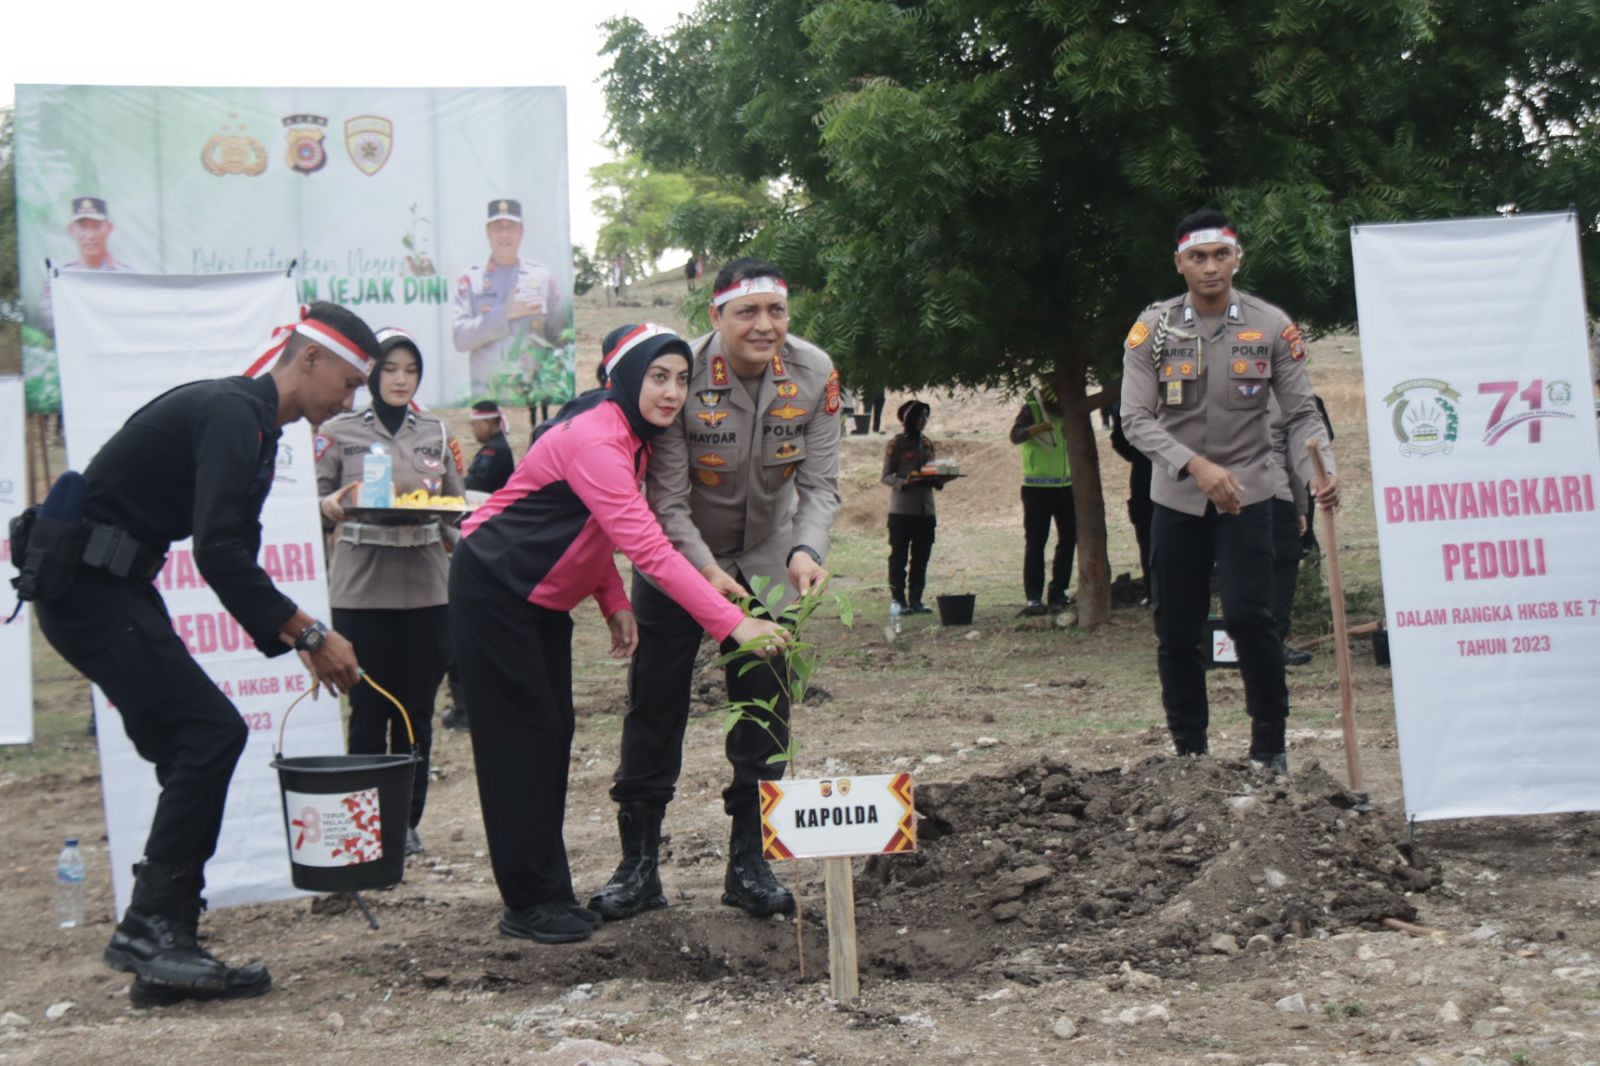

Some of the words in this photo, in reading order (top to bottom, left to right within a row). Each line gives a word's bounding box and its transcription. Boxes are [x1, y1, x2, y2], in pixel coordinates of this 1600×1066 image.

[328, 276, 394, 304] SEJAK
[404, 277, 448, 304] DINI
[1231, 346, 1268, 356] POLRI
[1478, 379, 1543, 444] 71
[1384, 474, 1595, 524] BHAYANGKARI
[1442, 538, 1546, 582] PEDULI
[1396, 609, 1447, 628] DALAM
[1452, 605, 1513, 625] RANGKA
[1518, 602, 1559, 621] HKGB
[1563, 600, 1584, 617] KE
[1588, 599, 1600, 617] 7
[1457, 637, 1507, 657] TAHUN
[1512, 635, 1551, 654] 2023
[238, 677, 280, 697] HKGB
[284, 673, 305, 692] KE
[794, 805, 878, 828] KAPOLDA
